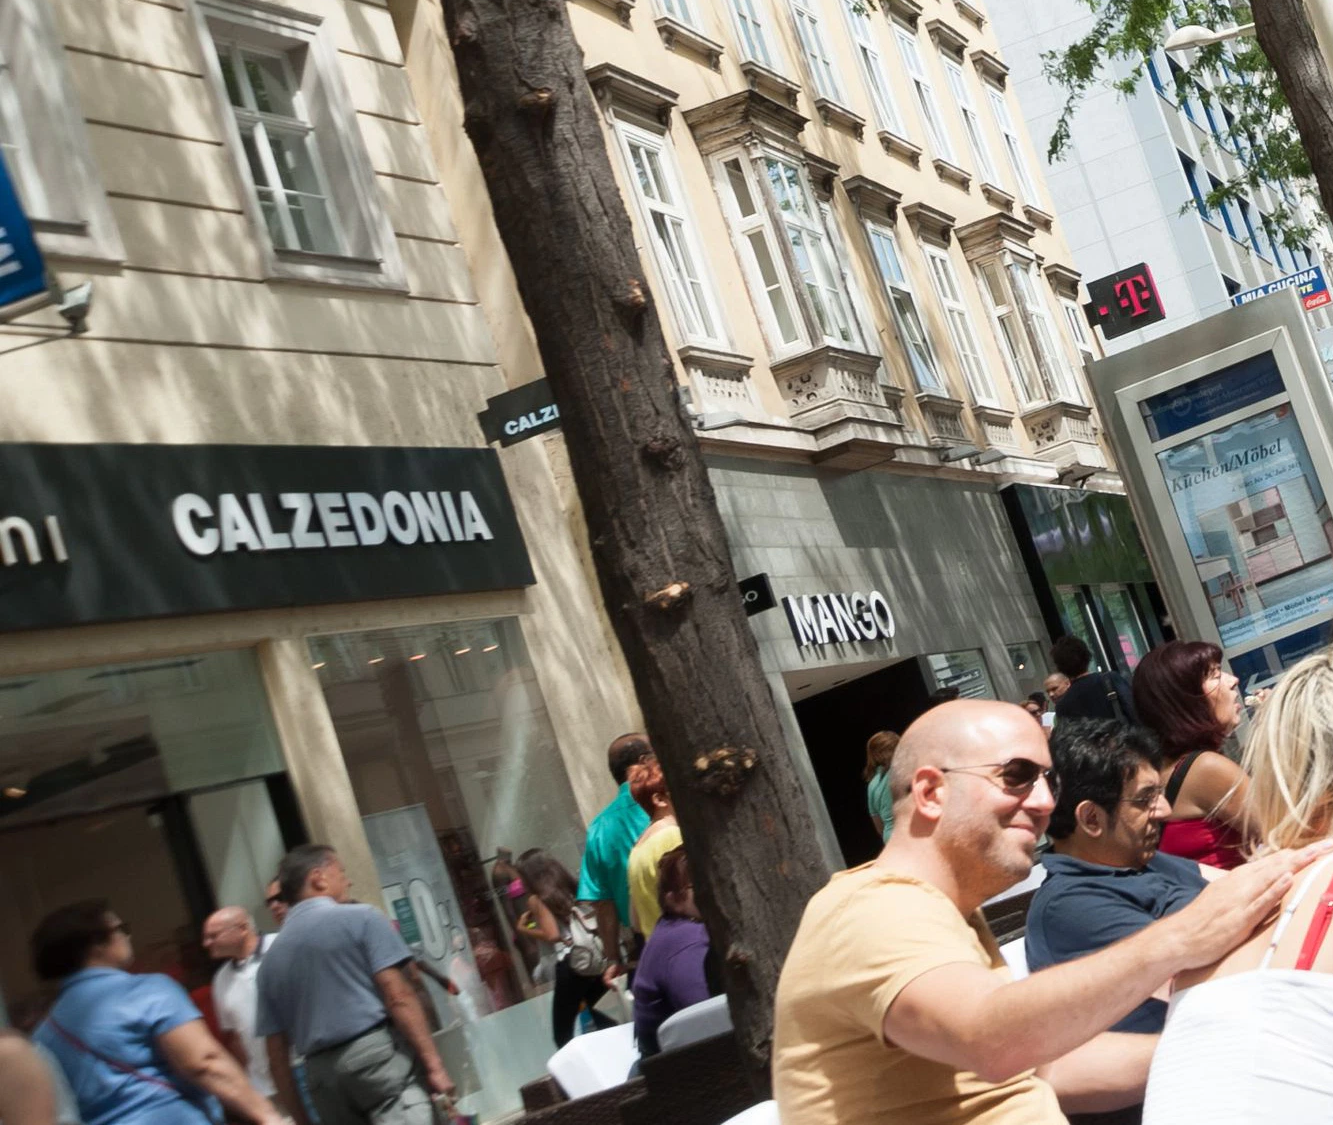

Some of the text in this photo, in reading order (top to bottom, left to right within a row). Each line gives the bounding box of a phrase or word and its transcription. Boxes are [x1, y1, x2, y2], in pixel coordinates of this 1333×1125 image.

[1241, 269, 1319, 304] MIA CUCINA
[1171, 437, 1283, 495] Küchen/Möbel
[171, 489, 494, 556] CALZEDONIA
[787, 590, 896, 647] MANGO
